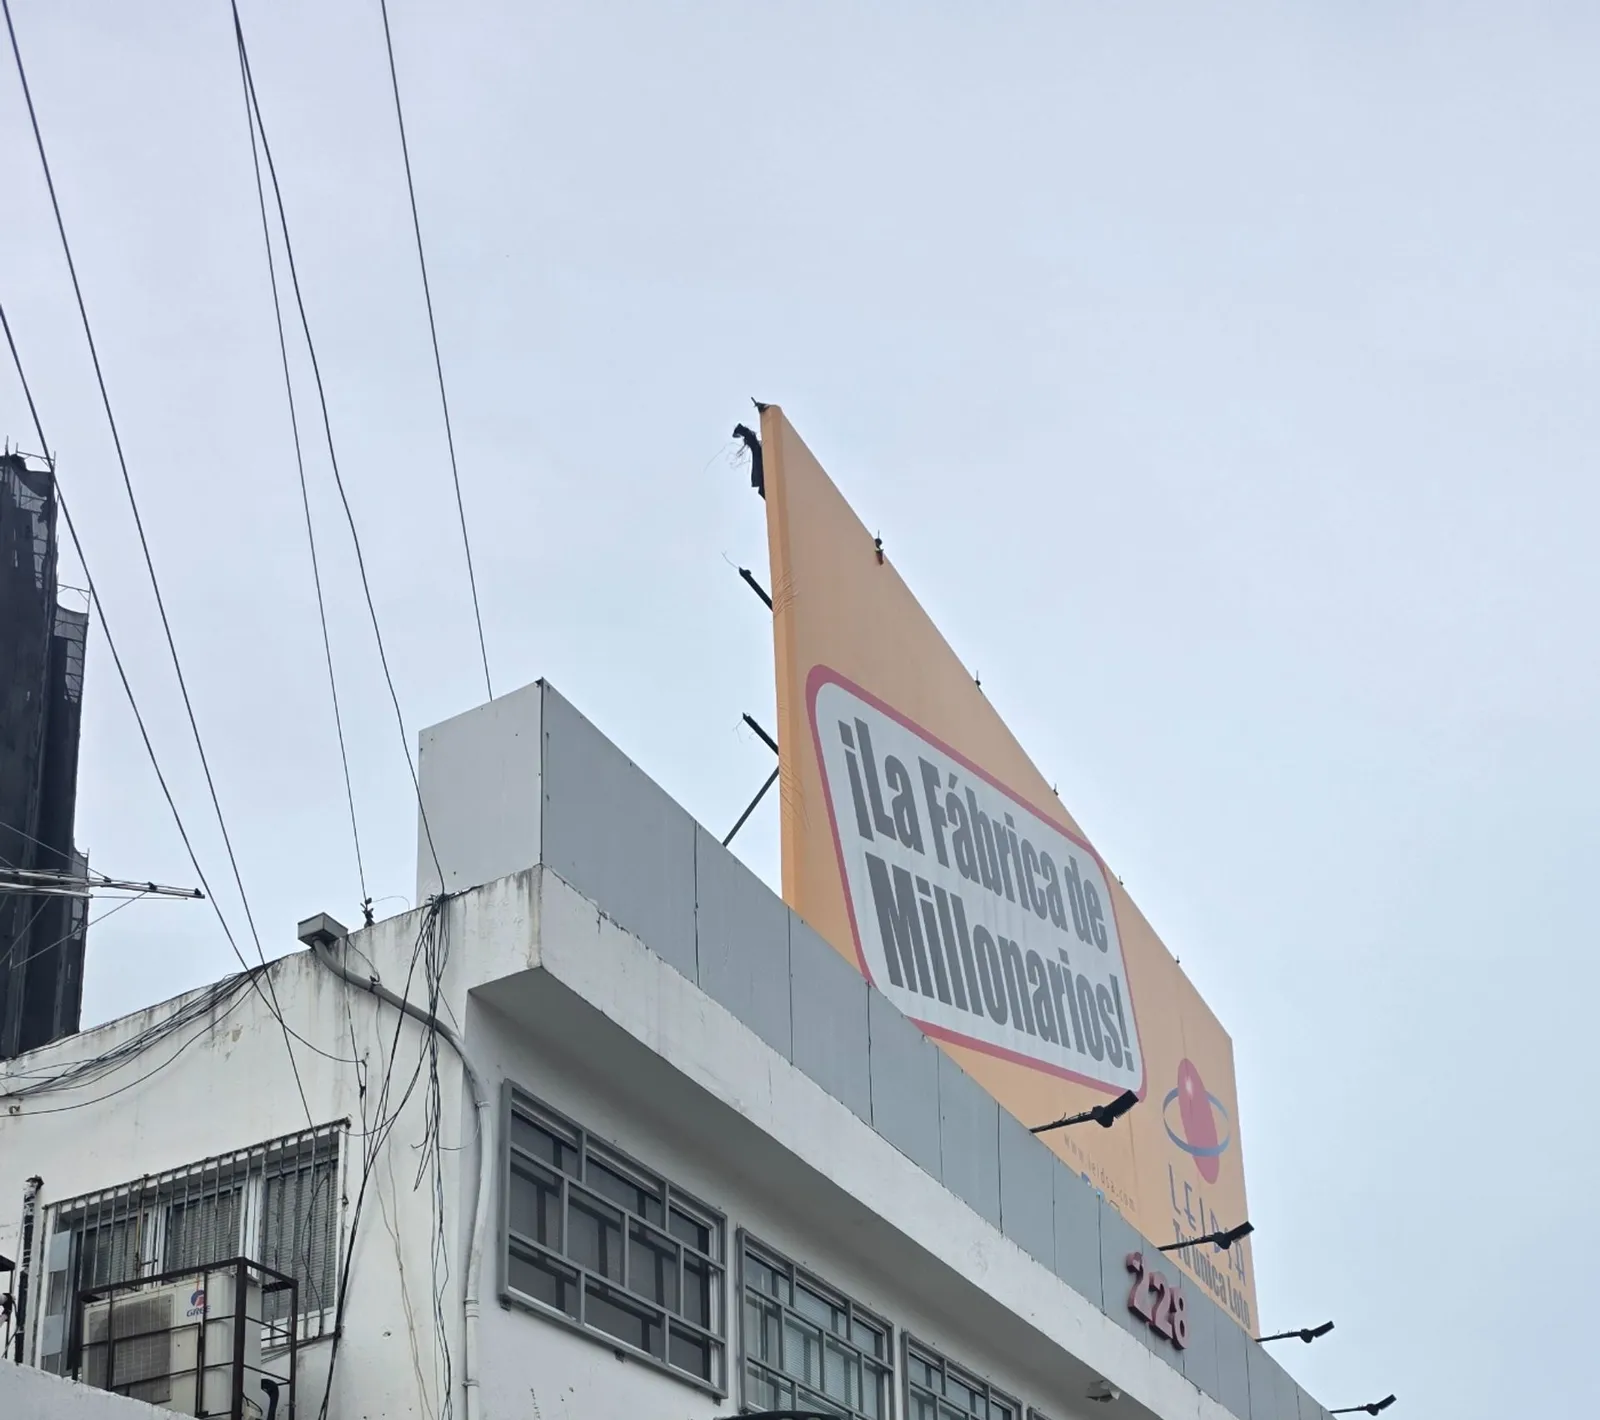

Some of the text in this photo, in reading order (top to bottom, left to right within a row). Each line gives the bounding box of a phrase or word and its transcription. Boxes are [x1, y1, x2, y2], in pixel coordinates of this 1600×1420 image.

[837, 715, 1109, 953] ¡La Fábrica de
[865, 851, 1135, 1072] Millonarios!
[1126, 1252, 1189, 1350] 228
